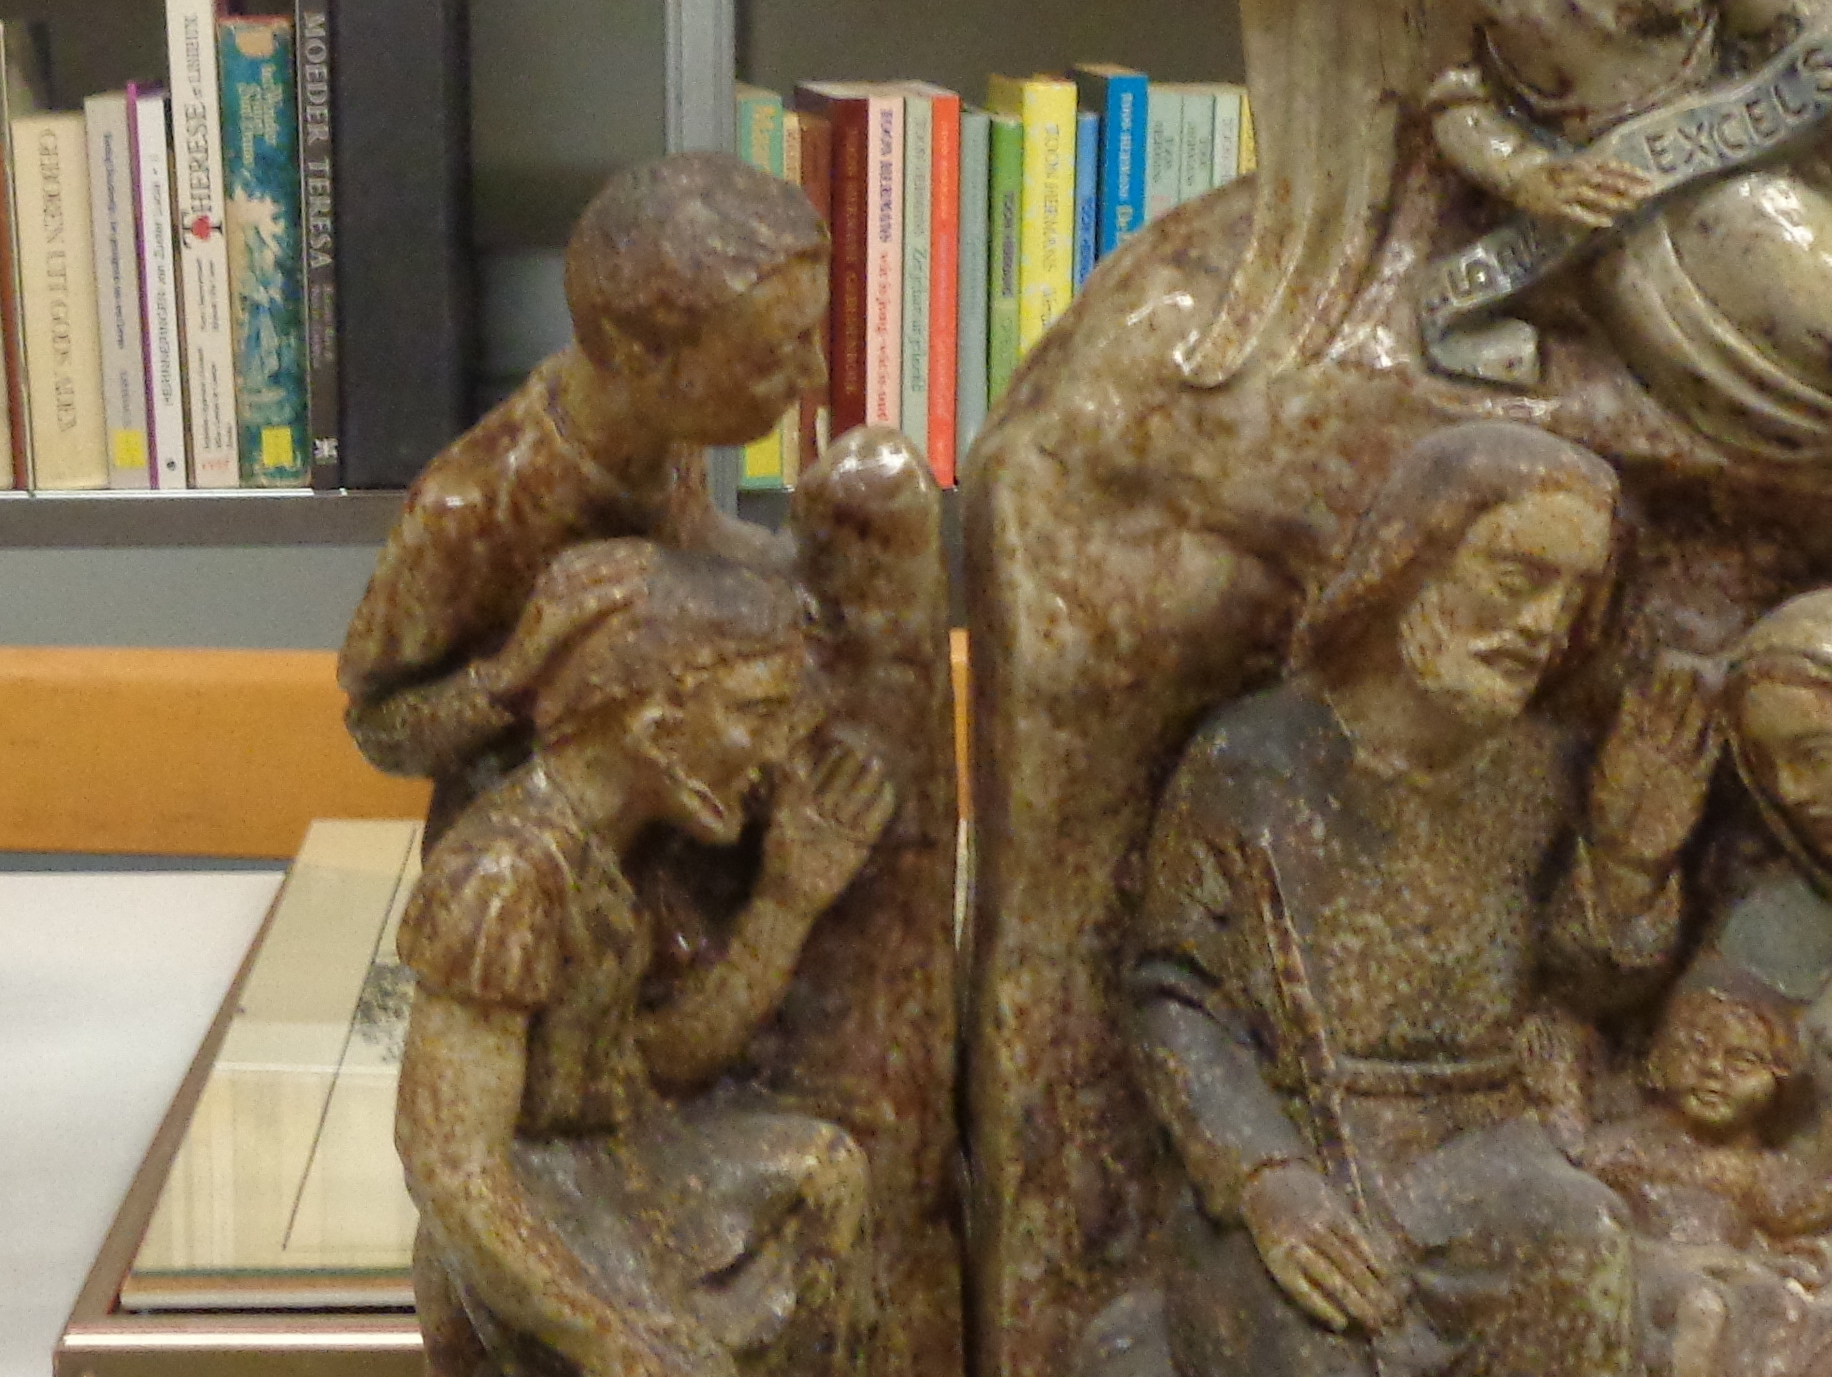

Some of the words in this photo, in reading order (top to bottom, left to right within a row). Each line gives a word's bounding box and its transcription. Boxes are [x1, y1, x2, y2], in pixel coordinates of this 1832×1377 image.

[304, 12, 328, 145] MOEDER
[39, 129, 66, 243] GEBOREN
[1043, 125, 1061, 178] TOON
[309, 157, 333, 268] TERESA
[1043, 181, 1062, 272] HERMANS
